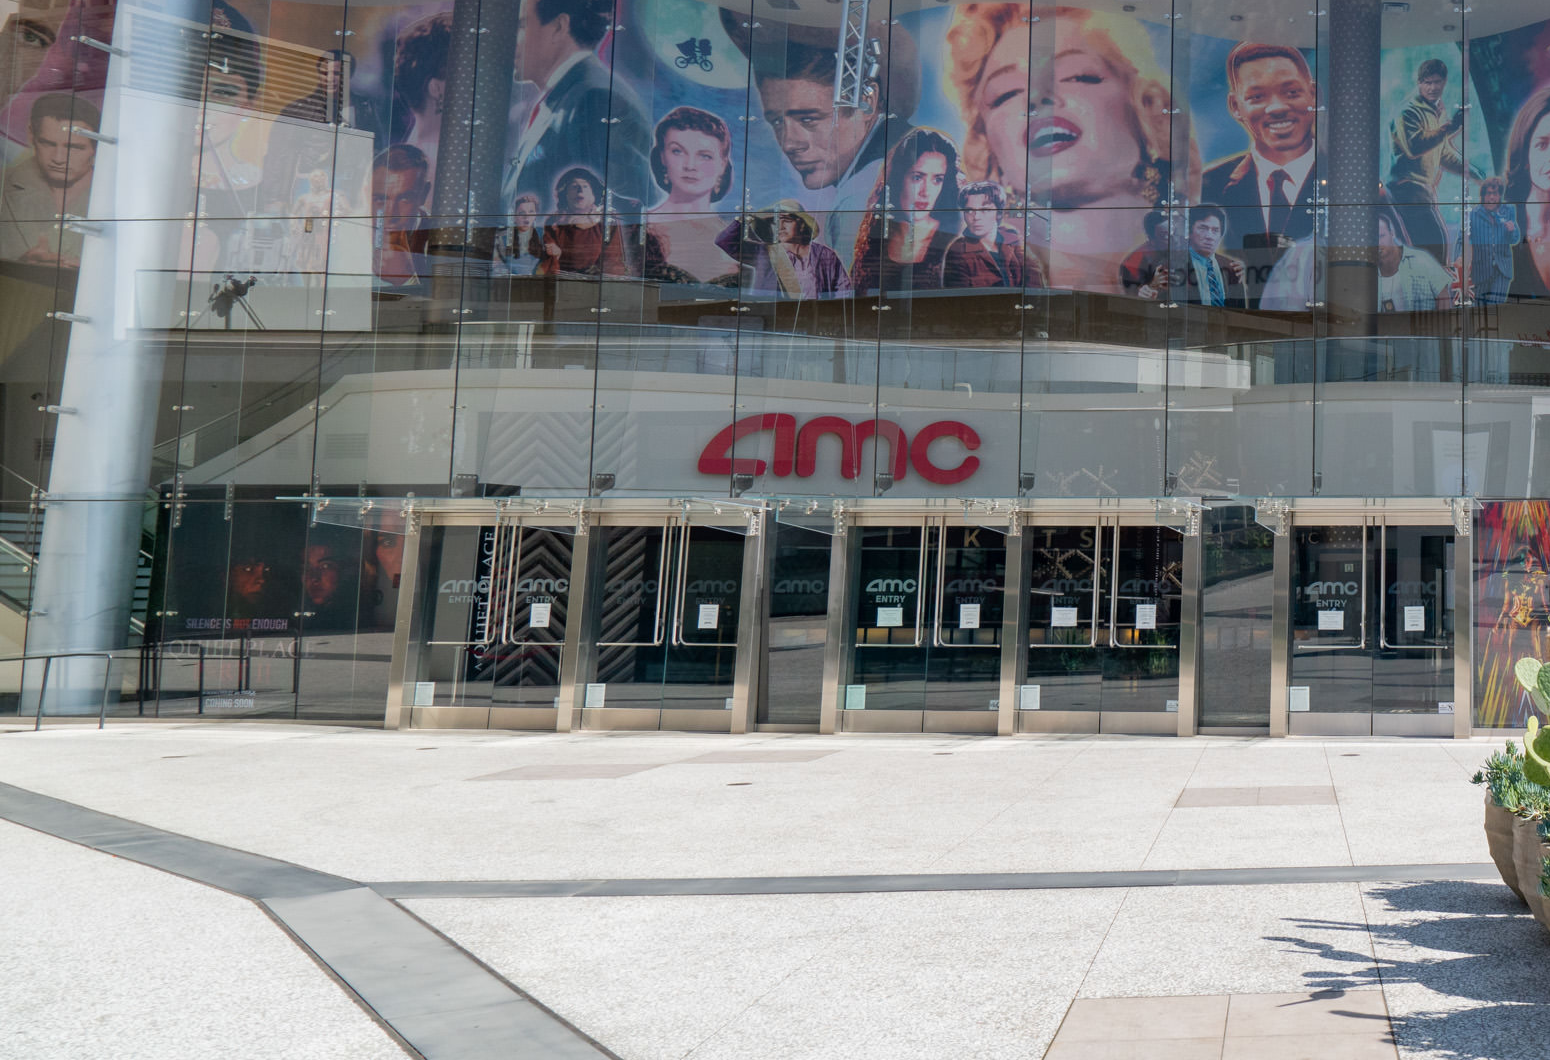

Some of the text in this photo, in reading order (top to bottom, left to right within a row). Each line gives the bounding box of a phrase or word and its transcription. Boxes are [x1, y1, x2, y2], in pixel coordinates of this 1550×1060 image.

[525, 595, 557, 604] ENTRY
[875, 595, 906, 603] ENTRY
[1316, 599, 1348, 608] ENTRY
[185, 618, 222, 630] SILENCE
[252, 618, 288, 630] ENOUGH
[205, 698, 255, 709] COMING SOON
